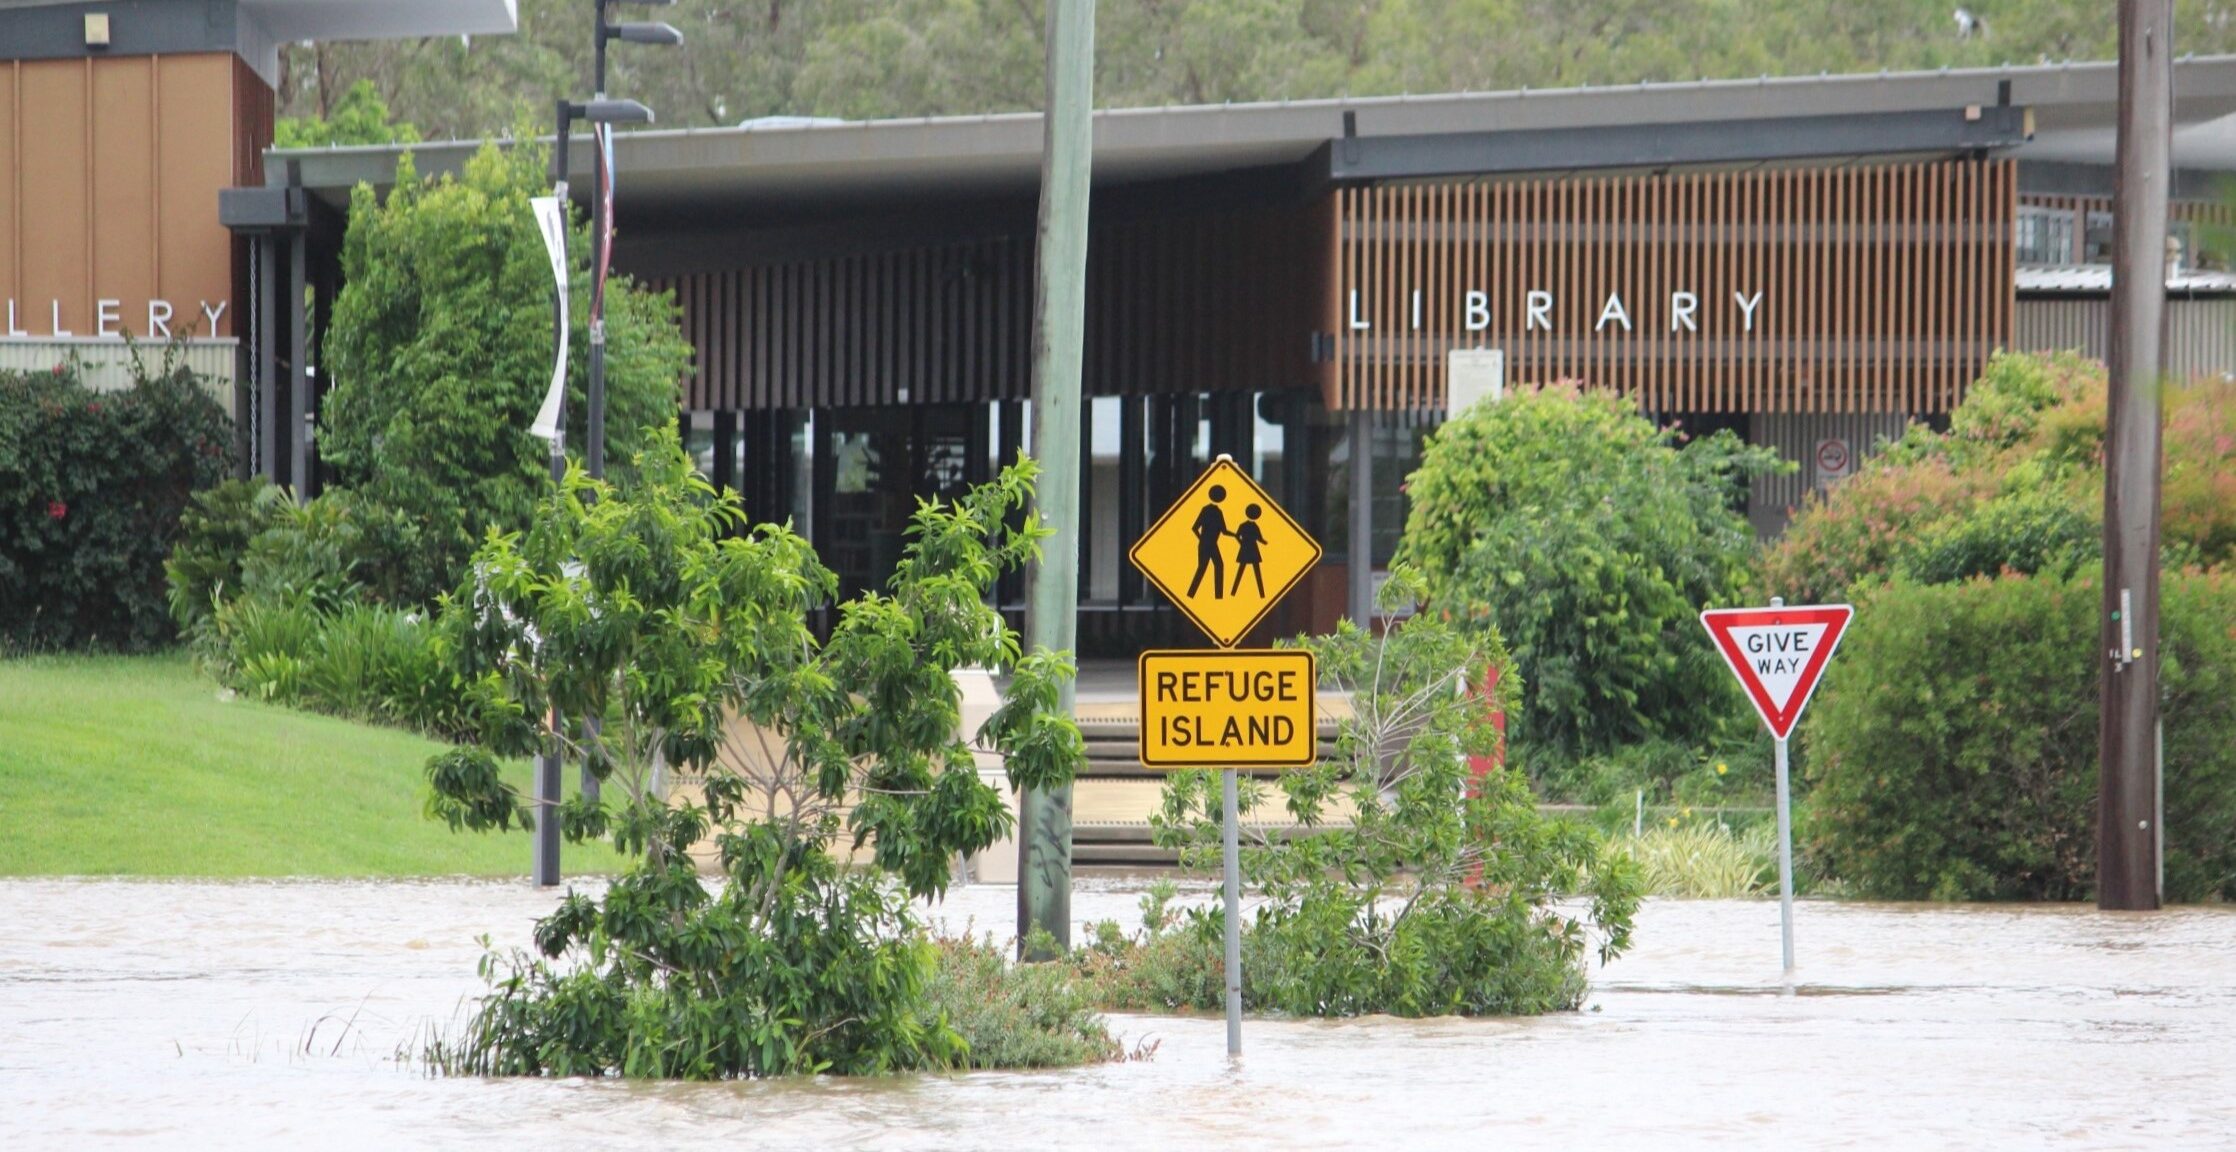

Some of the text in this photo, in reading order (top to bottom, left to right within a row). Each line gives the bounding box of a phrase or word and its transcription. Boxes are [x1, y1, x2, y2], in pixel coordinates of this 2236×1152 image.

[8, 298, 227, 338] LLERY
[1349, 289, 1763, 332] LIBRARY
[1748, 632, 1808, 653] GIVE
[1758, 658, 1799, 674] WAY
[1157, 671, 1297, 702] REFUGE
[1161, 715, 1294, 747] ISLAND
